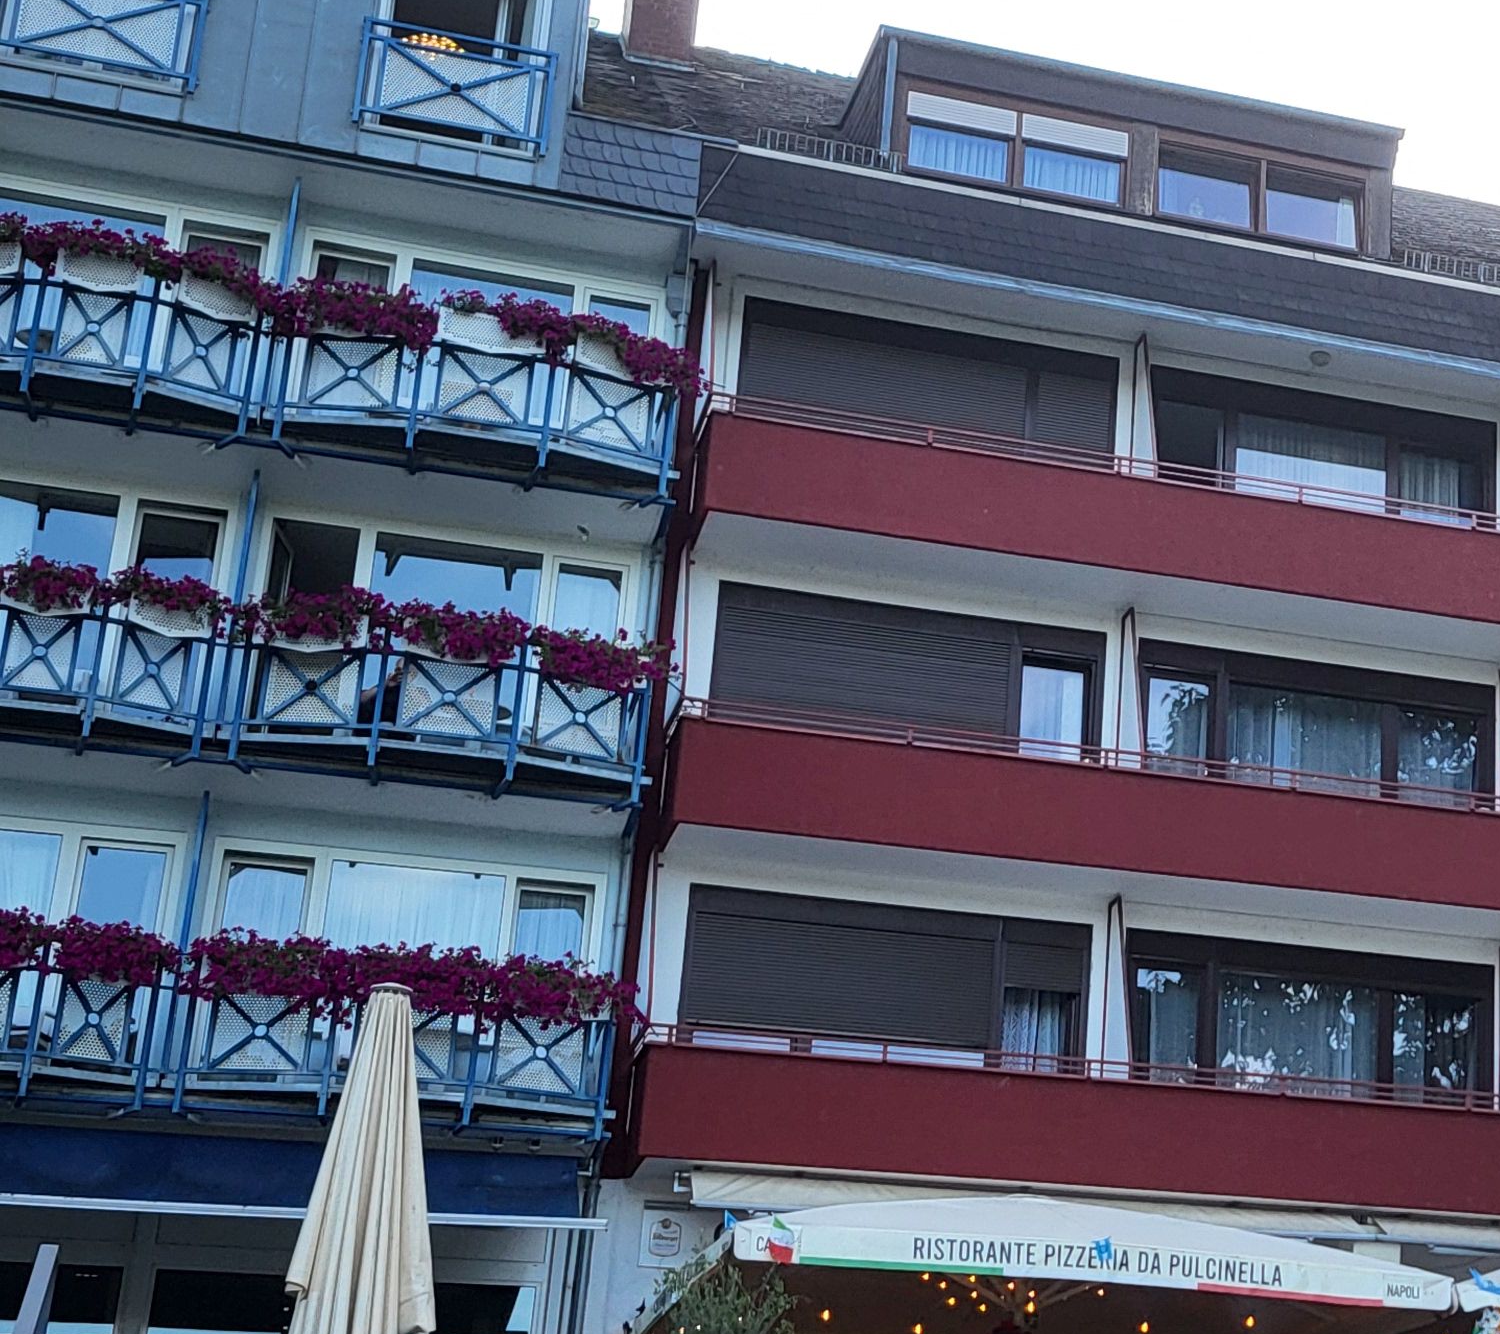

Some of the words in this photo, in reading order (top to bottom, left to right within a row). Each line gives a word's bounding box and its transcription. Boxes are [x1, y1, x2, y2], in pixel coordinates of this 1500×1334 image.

[913, 1237, 1036, 1266] RISTORANTE
[1138, 1251, 1161, 1275] DA
[1169, 1253, 1283, 1288] PULCINELLA
[1386, 1282, 1420, 1300] NAPOLI
